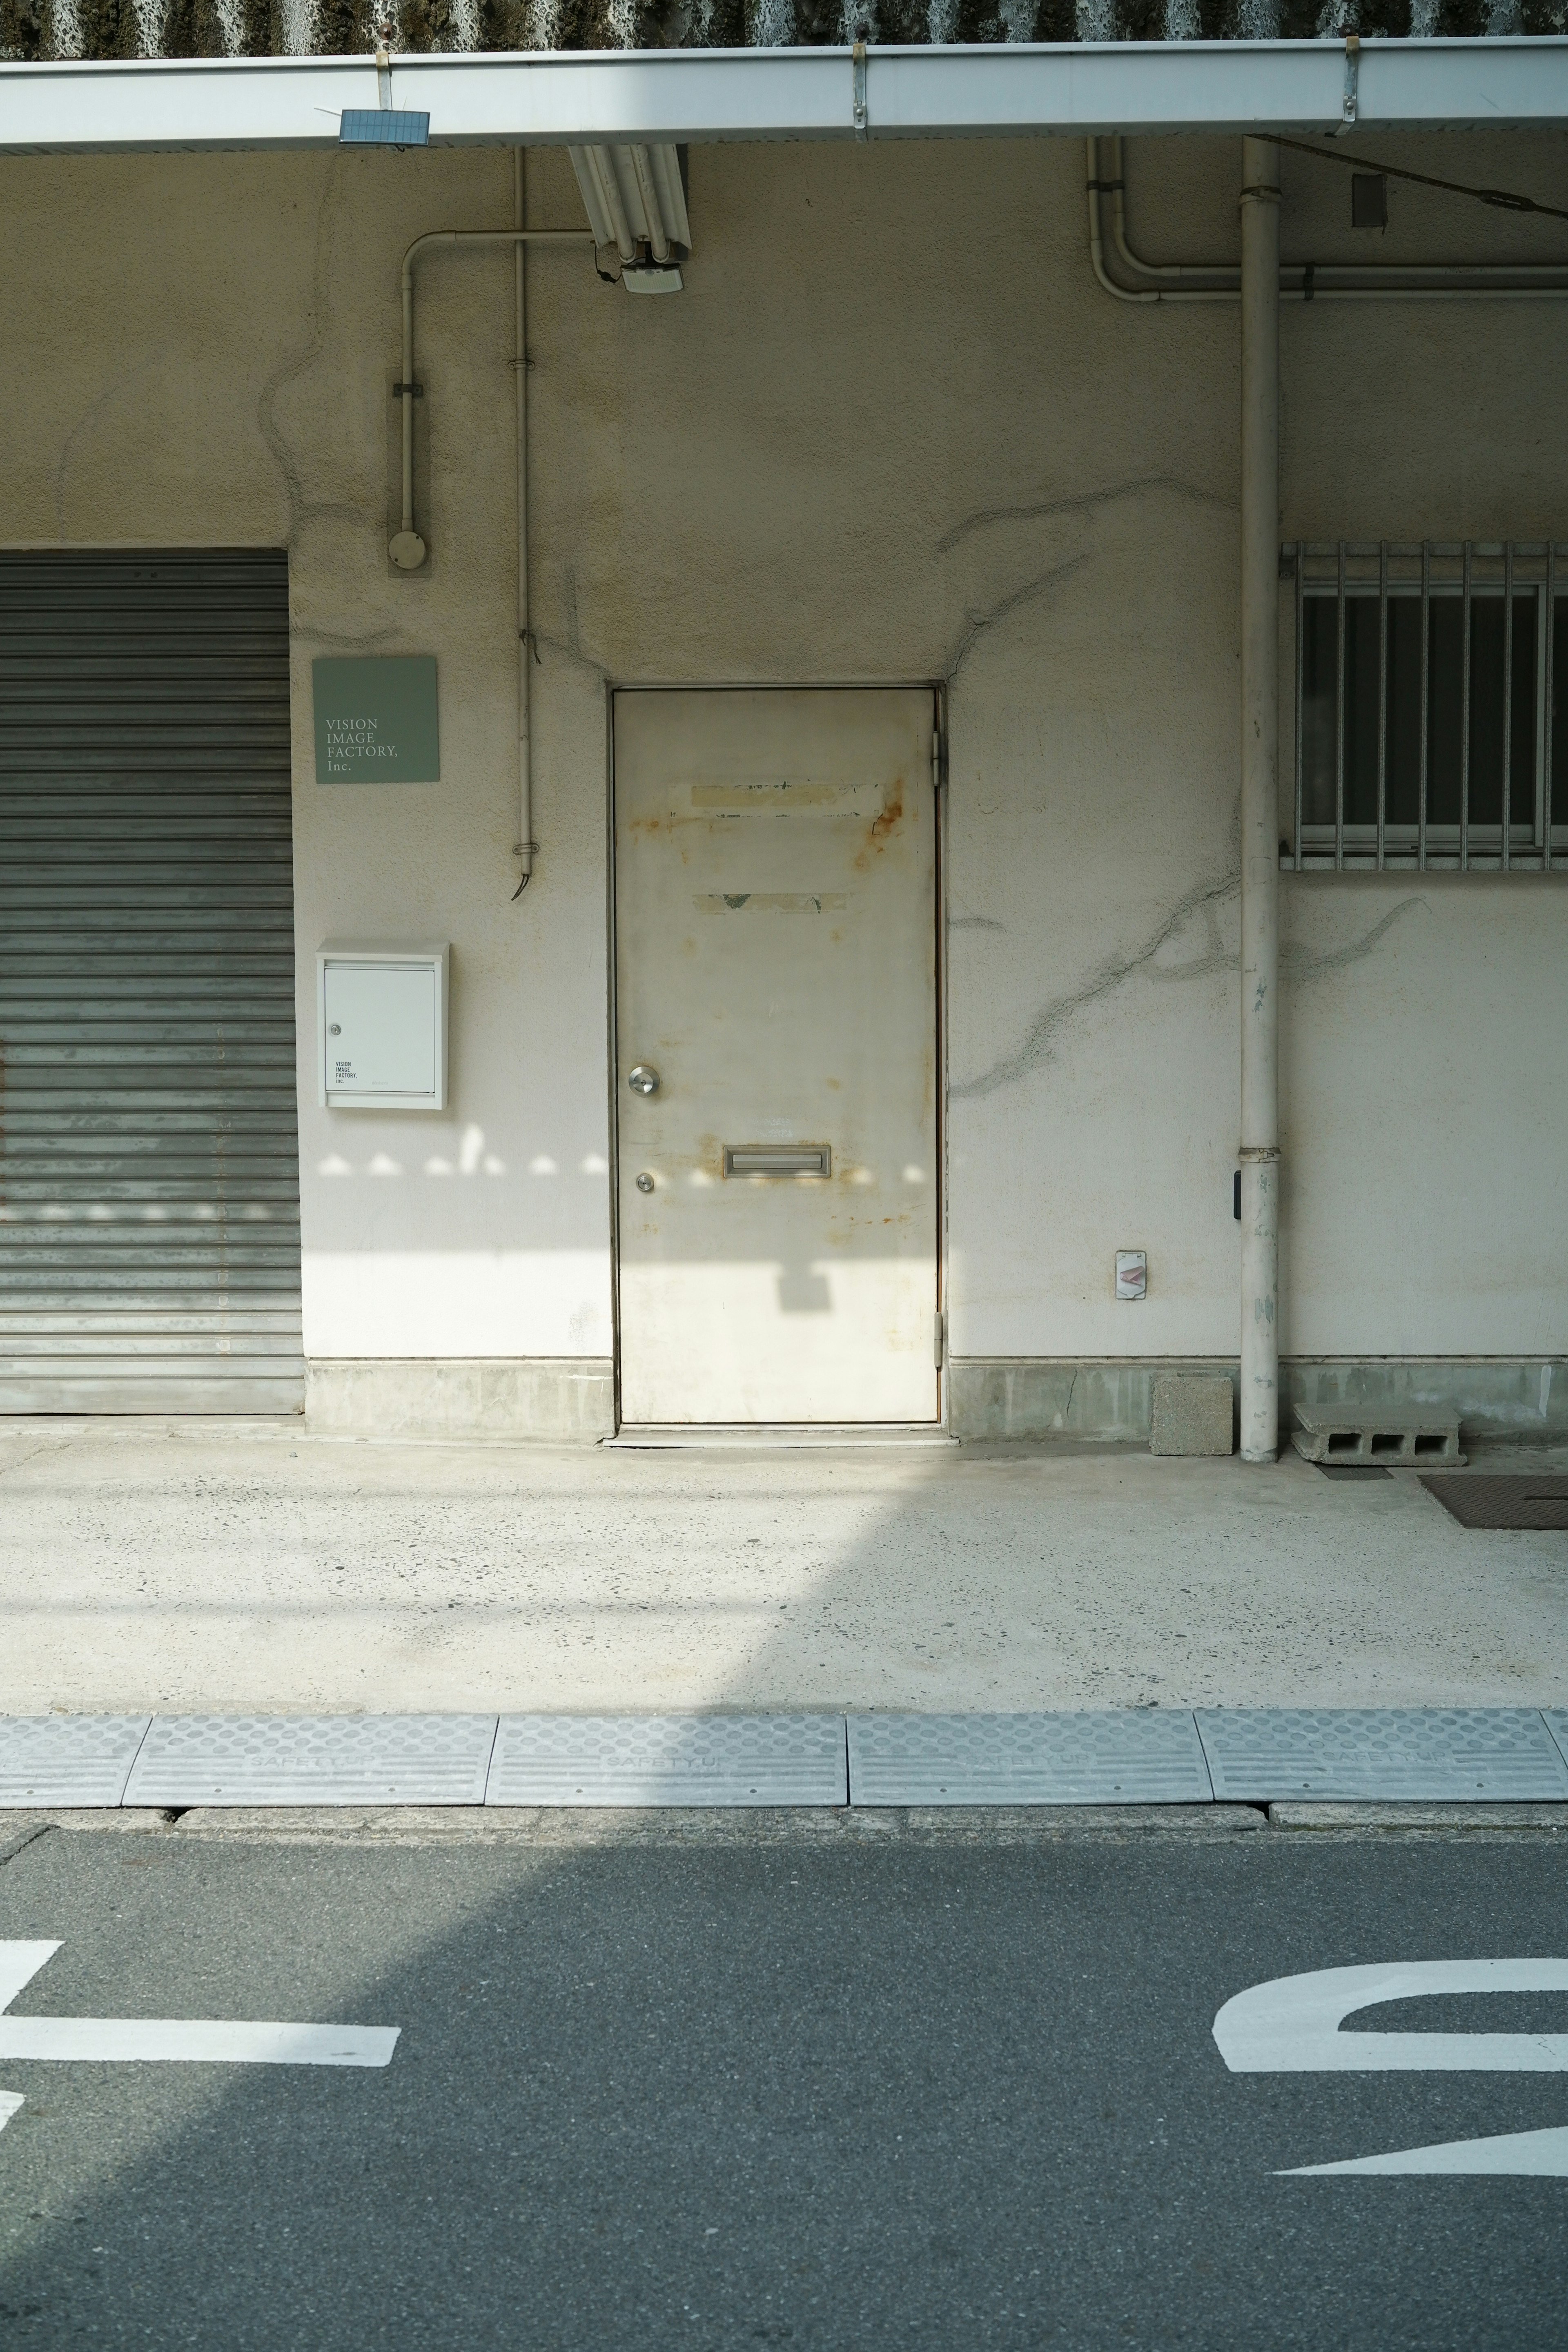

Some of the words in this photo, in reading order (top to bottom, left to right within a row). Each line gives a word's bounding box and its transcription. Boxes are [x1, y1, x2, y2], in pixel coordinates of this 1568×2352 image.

[326, 719, 378, 730] VISION
[327, 733, 374, 744] IMAGE
[327, 746, 398, 758] FACTORY,
[327, 761, 351, 771] Inc.
